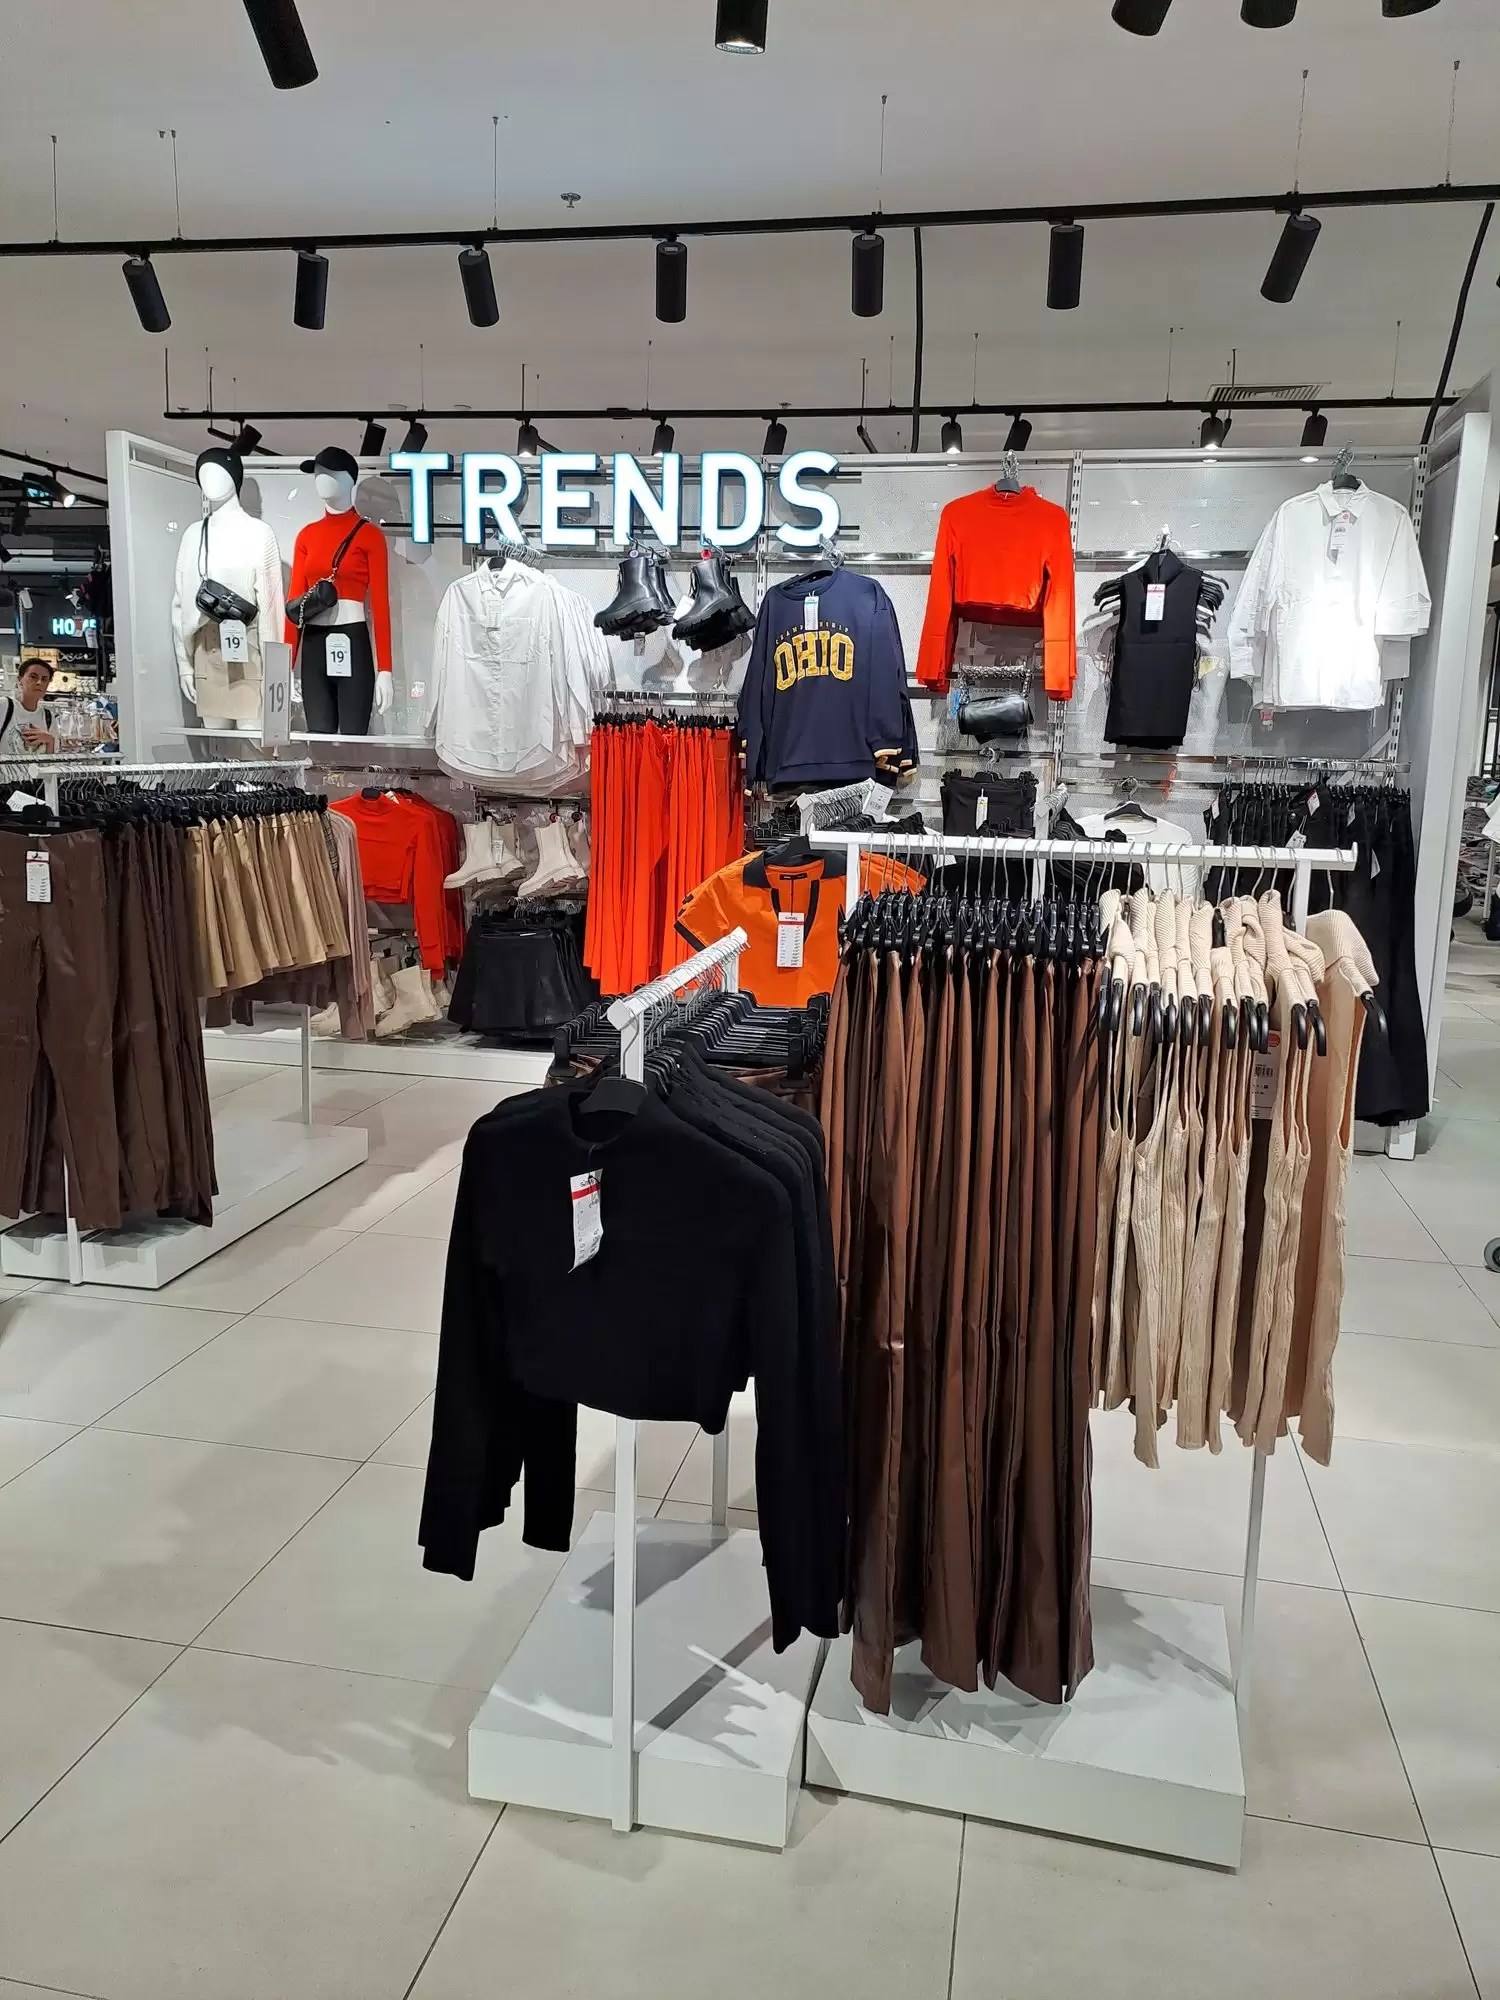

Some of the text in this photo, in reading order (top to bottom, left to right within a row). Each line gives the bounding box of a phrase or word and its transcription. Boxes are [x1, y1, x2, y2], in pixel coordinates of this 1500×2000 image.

[389, 450, 842, 548] TRENDS
[225, 636, 241, 649] 19
[330, 650, 345, 663] 19
[773, 630, 855, 691] OHIO
[269, 682, 285, 713] 19
